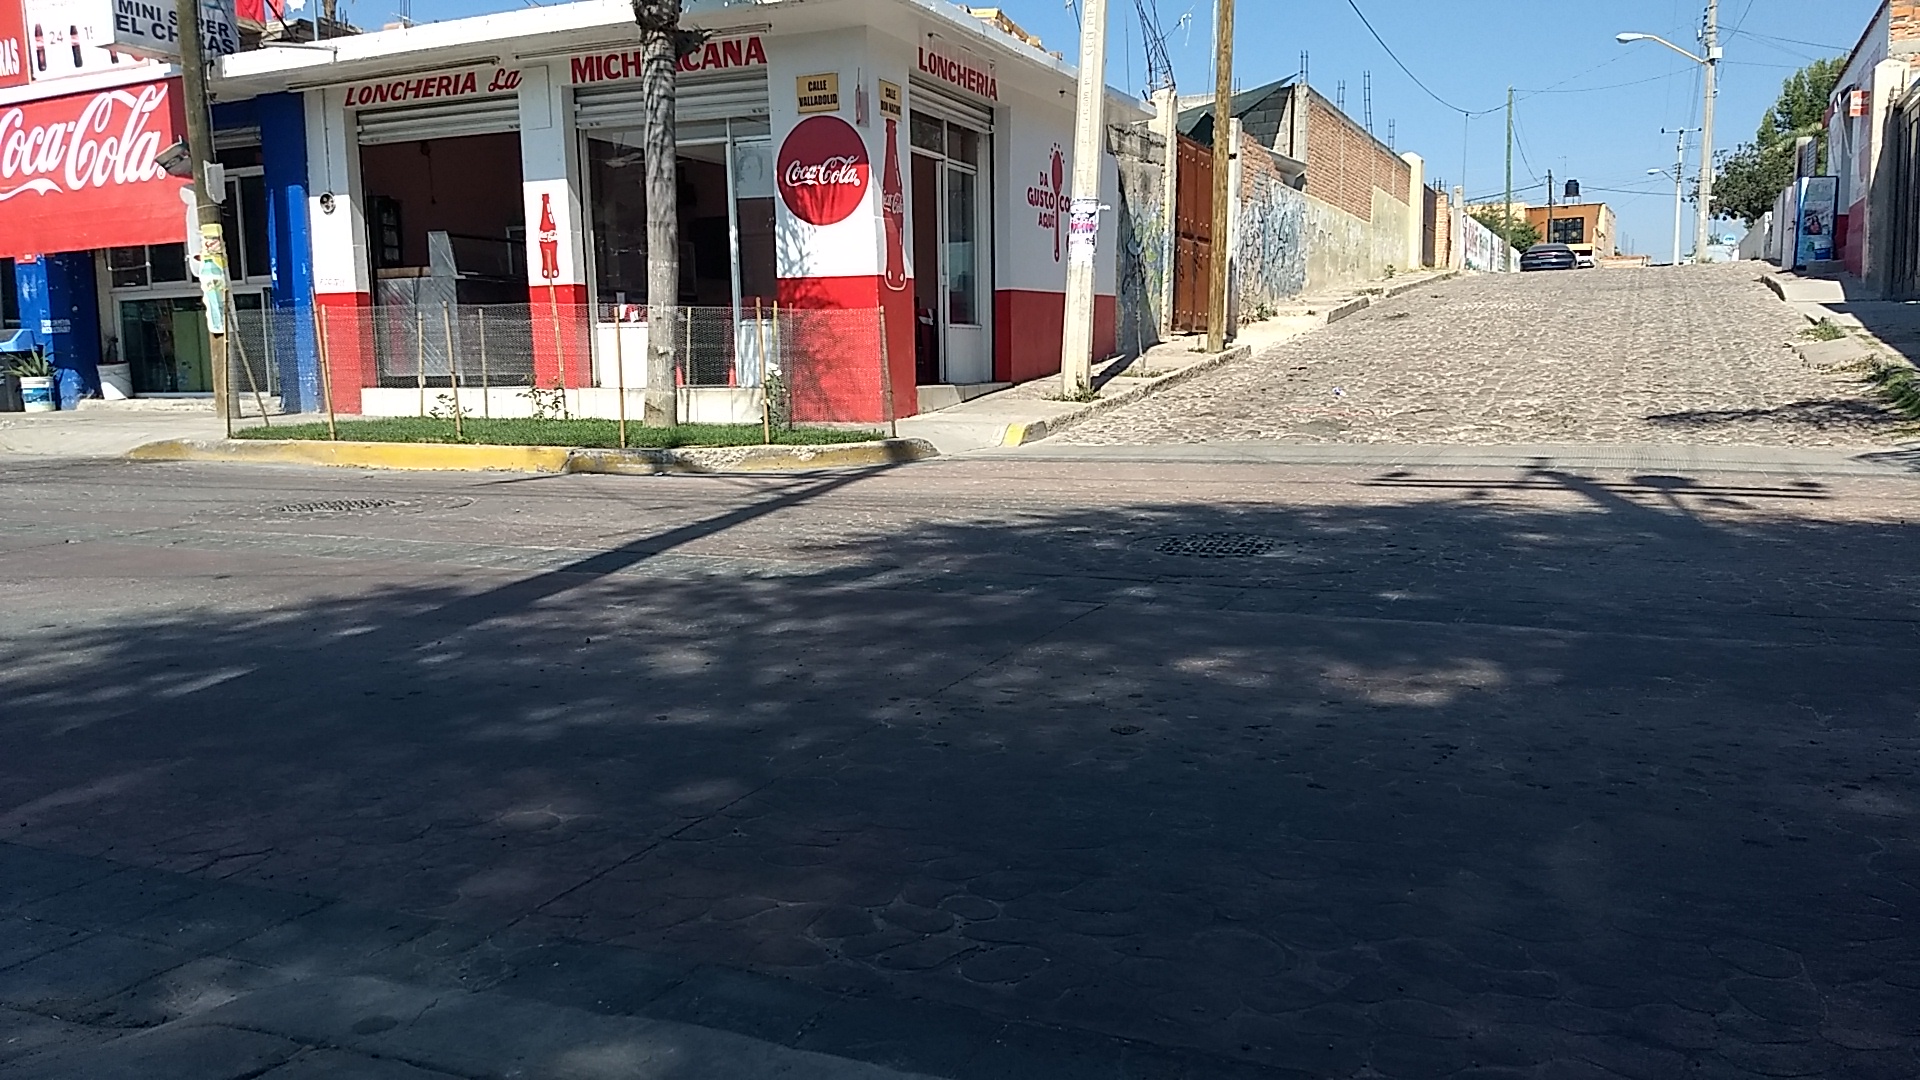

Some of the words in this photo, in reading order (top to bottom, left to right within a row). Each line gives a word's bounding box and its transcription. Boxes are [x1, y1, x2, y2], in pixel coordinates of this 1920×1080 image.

[115, 14, 145, 36] EL
[118, 0, 162, 22] MINI
[168, 10, 230, 38] SER
[344, 72, 477, 107] LONCHERIA
[487, 68, 522, 92] La
[807, 79, 827, 92] CALLE
[918, 46, 998, 102] LONCHERIA
[798, 93, 838, 107] VALLADOLID
[0, 82, 169, 191] Coca-Cola
[785, 155, 860, 187] Coca-Cola
[1039, 171, 1049, 188] DA
[1027, 186, 1055, 210] GUSTO
